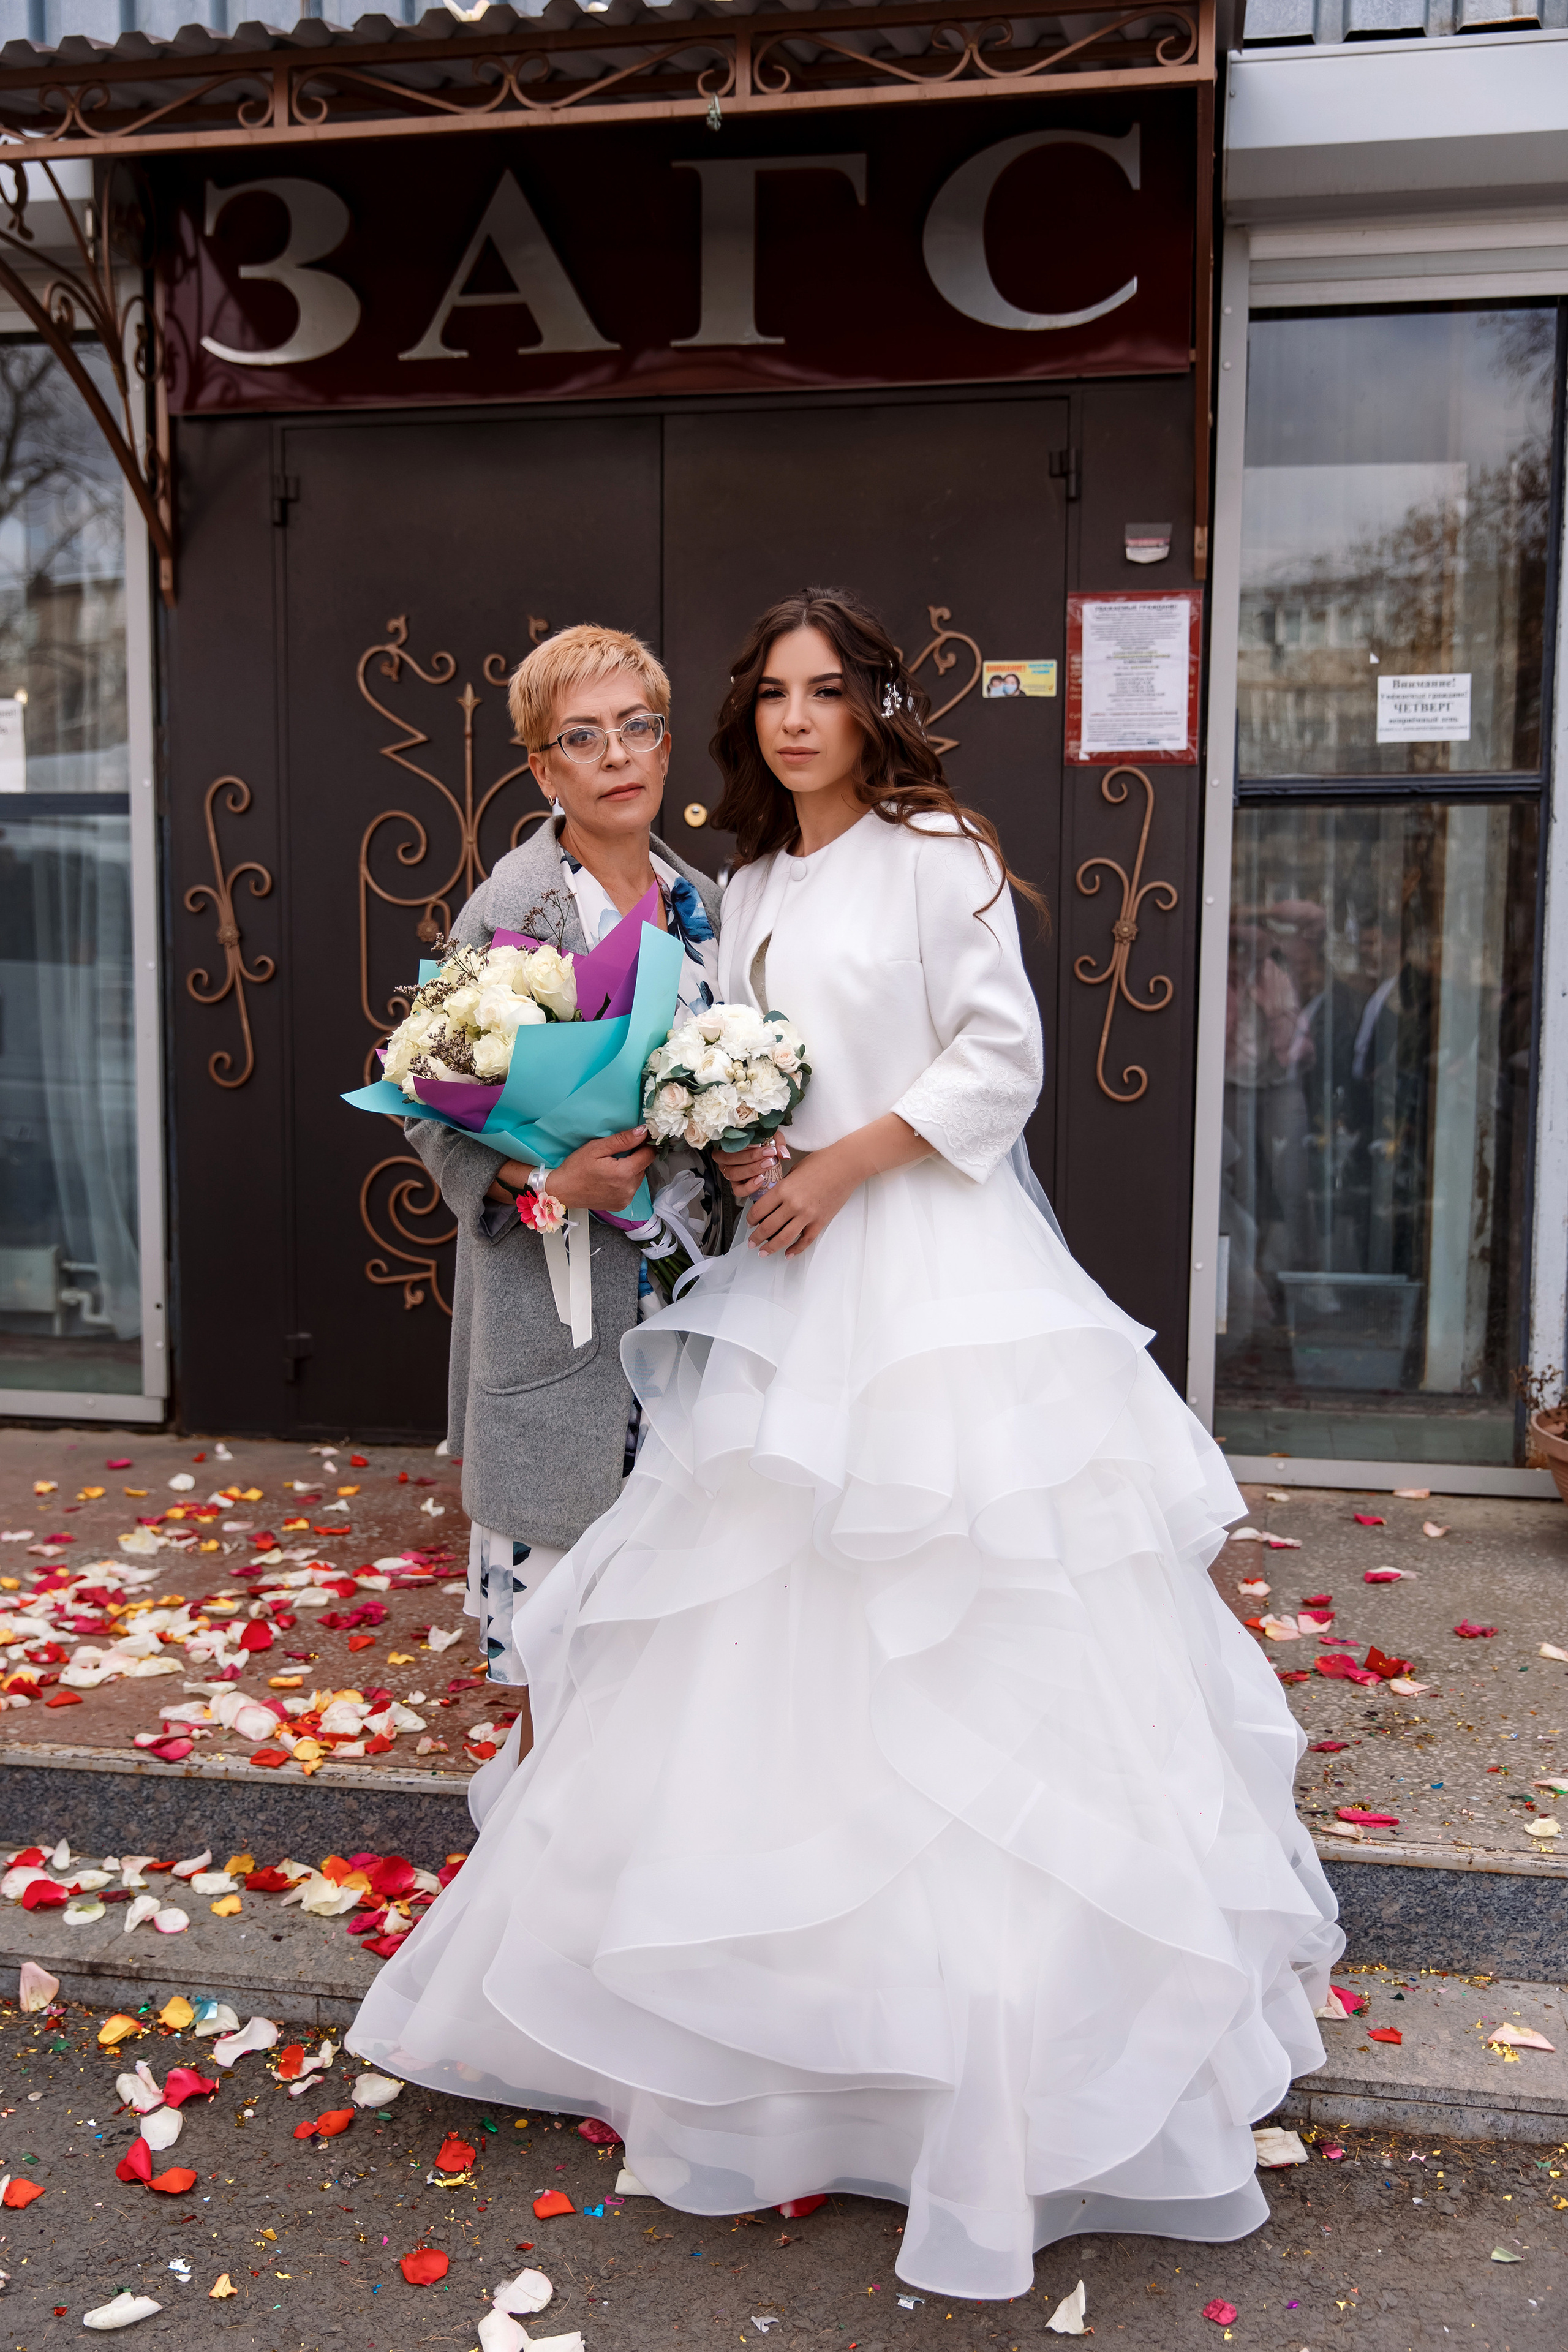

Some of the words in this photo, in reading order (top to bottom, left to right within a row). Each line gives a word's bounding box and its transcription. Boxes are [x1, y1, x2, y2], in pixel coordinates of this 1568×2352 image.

[200, 123, 1140, 365] ЗАГС
[1392, 678, 1457, 690] Внимание!
[1393, 702, 1454, 714] ЧЕТВЕРГ
